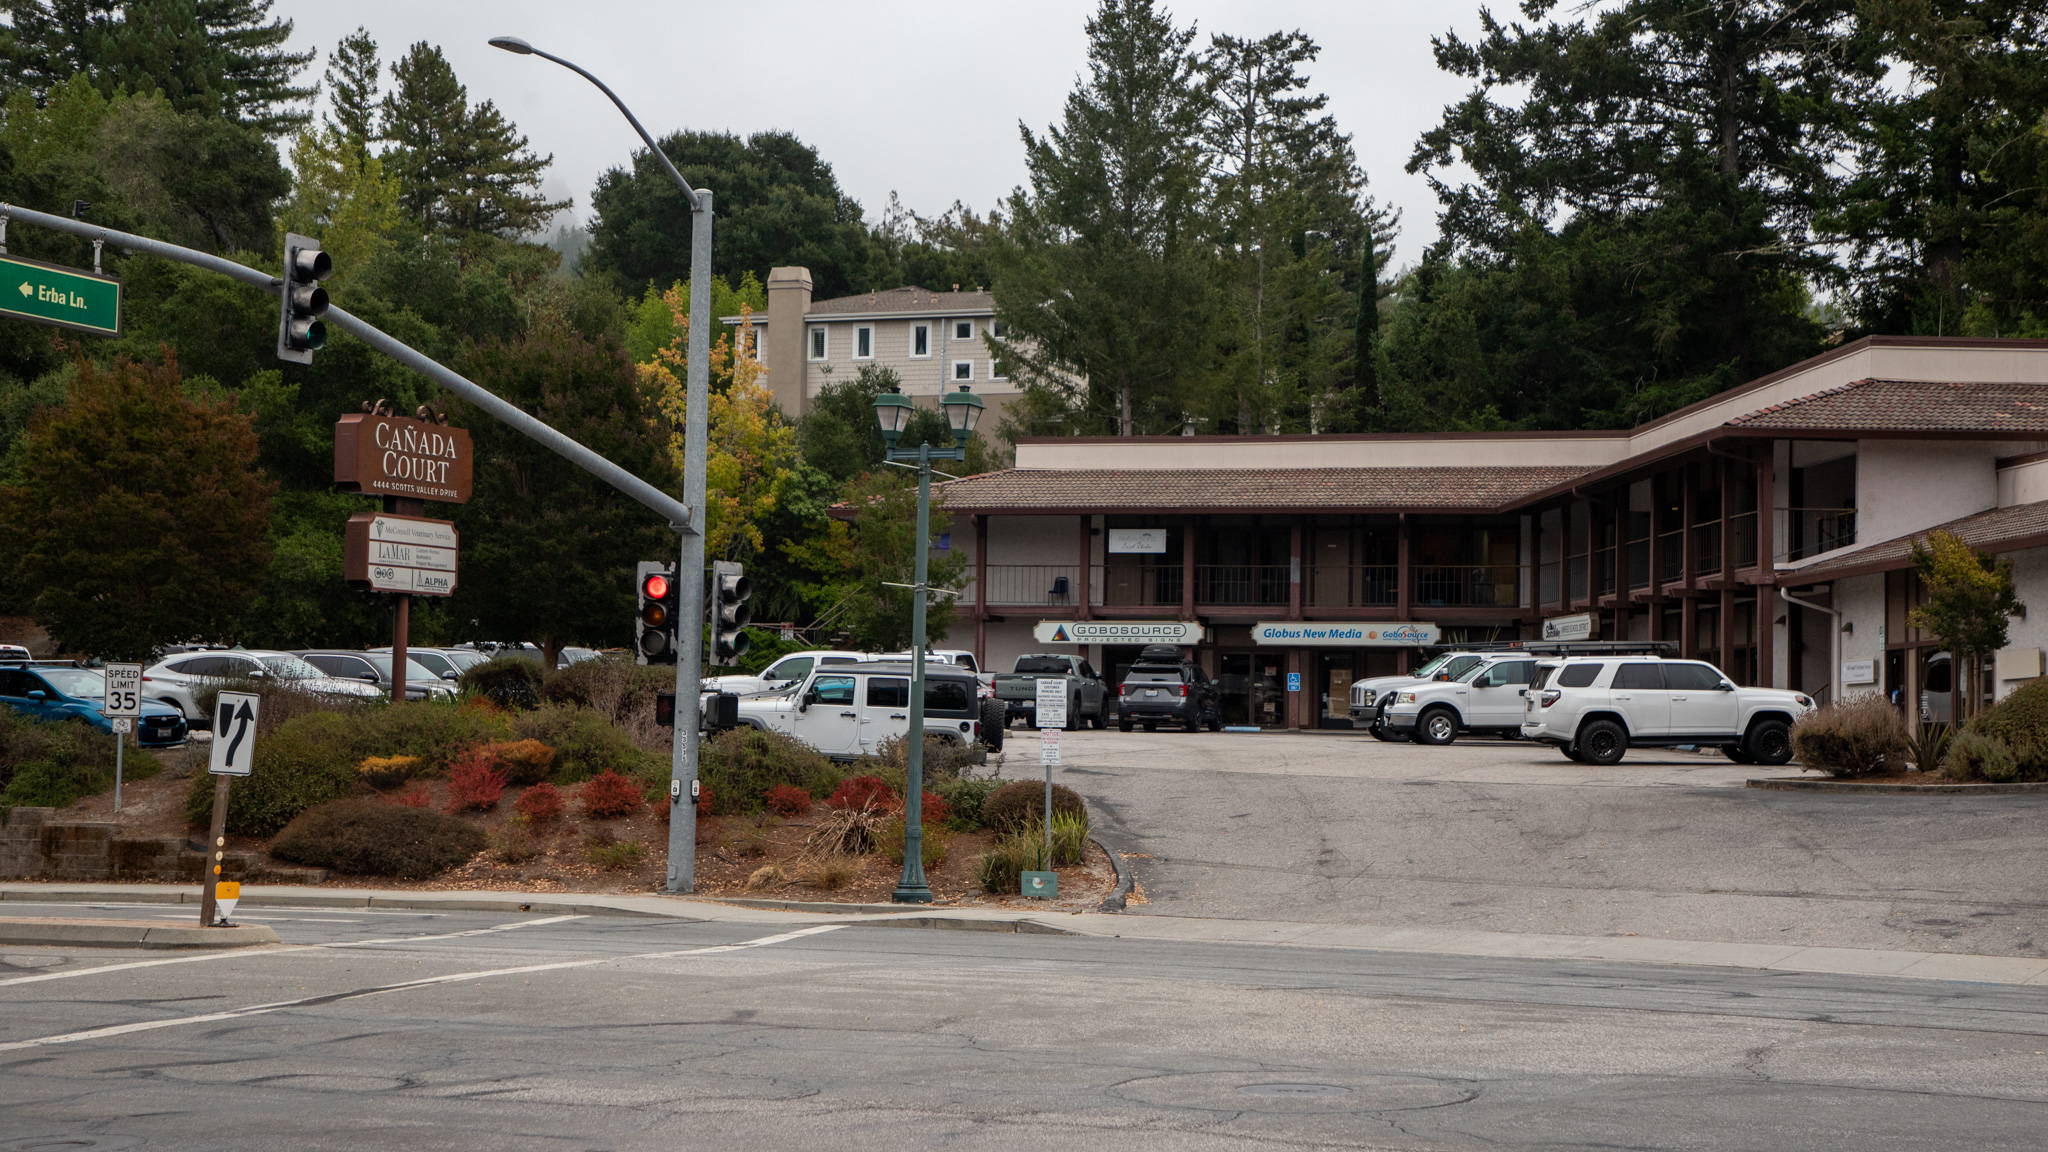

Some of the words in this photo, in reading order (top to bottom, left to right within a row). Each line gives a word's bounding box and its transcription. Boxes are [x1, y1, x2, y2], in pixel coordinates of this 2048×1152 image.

[38, 284, 66, 305] Erba
[70, 291, 88, 310] Ln.
[376, 422, 456, 459] CAÑADA
[382, 450, 450, 484] COURT
[372, 480, 390, 489] 4444
[391, 482, 414, 492] SCOTTS
[416, 486, 438, 495] VALLEY
[440, 488, 458, 498] DRIVE
[412, 530, 434, 540] Veterinary
[435, 532, 451, 540] Service
[425, 577, 448, 586] ALPHA
[1077, 627, 1181, 635] GOBOSOURCE
[1264, 629, 1300, 638] Globus
[1303, 629, 1327, 638] New
[1328, 629, 1362, 638] Media
[108, 670, 138, 678] SPEED
[110, 692, 136, 710] 35
